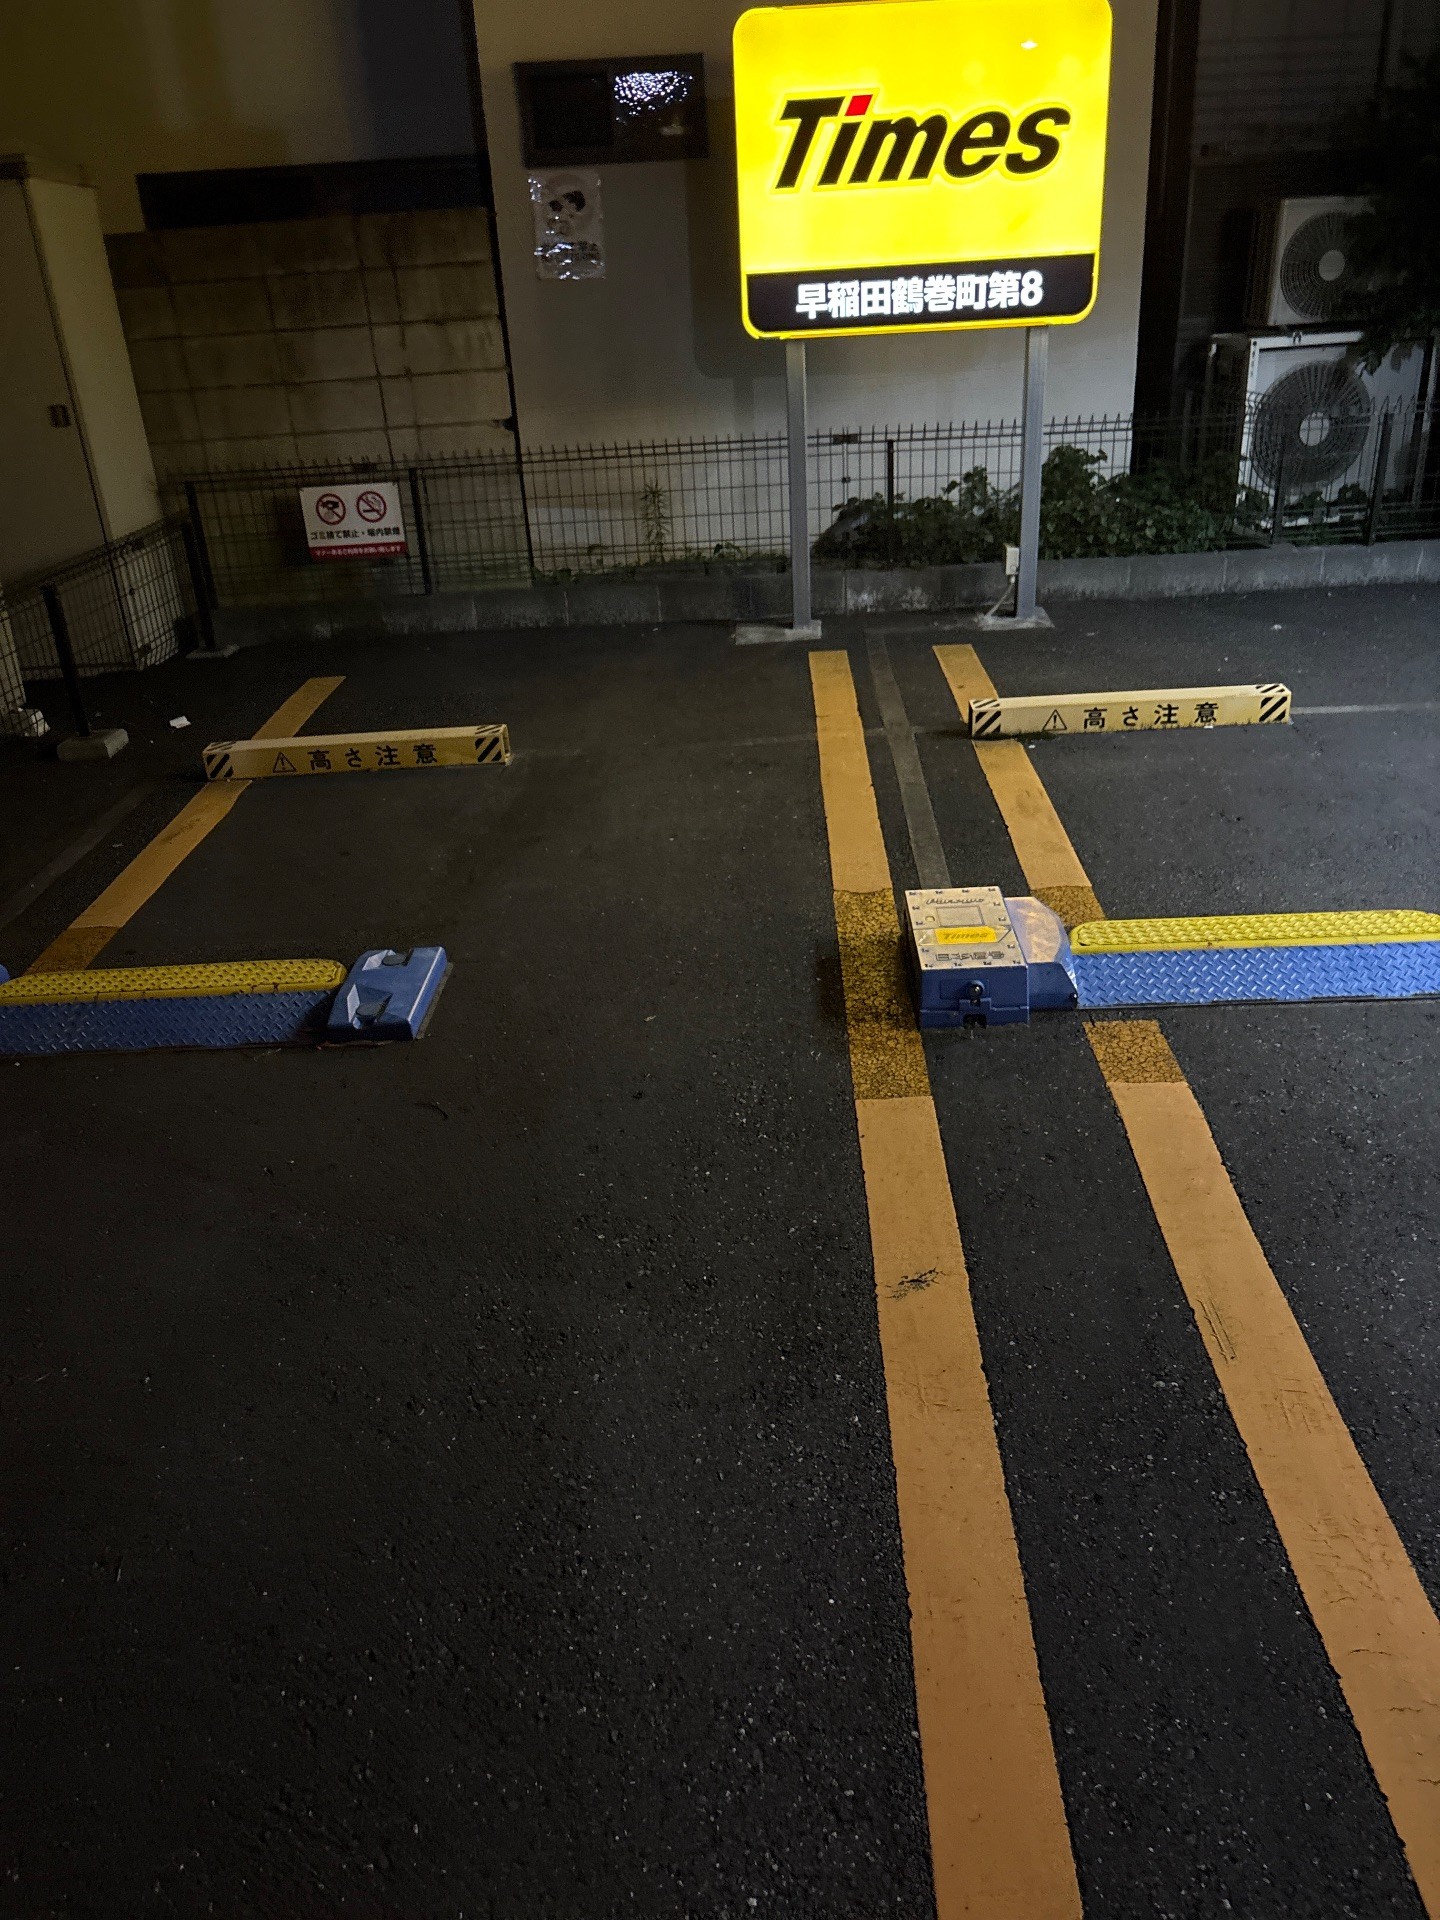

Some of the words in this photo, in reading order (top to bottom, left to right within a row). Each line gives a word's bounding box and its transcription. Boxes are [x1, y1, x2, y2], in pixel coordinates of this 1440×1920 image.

[775, 94, 1071, 189] Times
[796, 270, 1043, 320] 早稲田鶴巻町第8
[1083, 702, 1219, 729] 高さ注意
[307, 743, 438, 770] 高さ注意
[943, 932, 989, 941] Times
